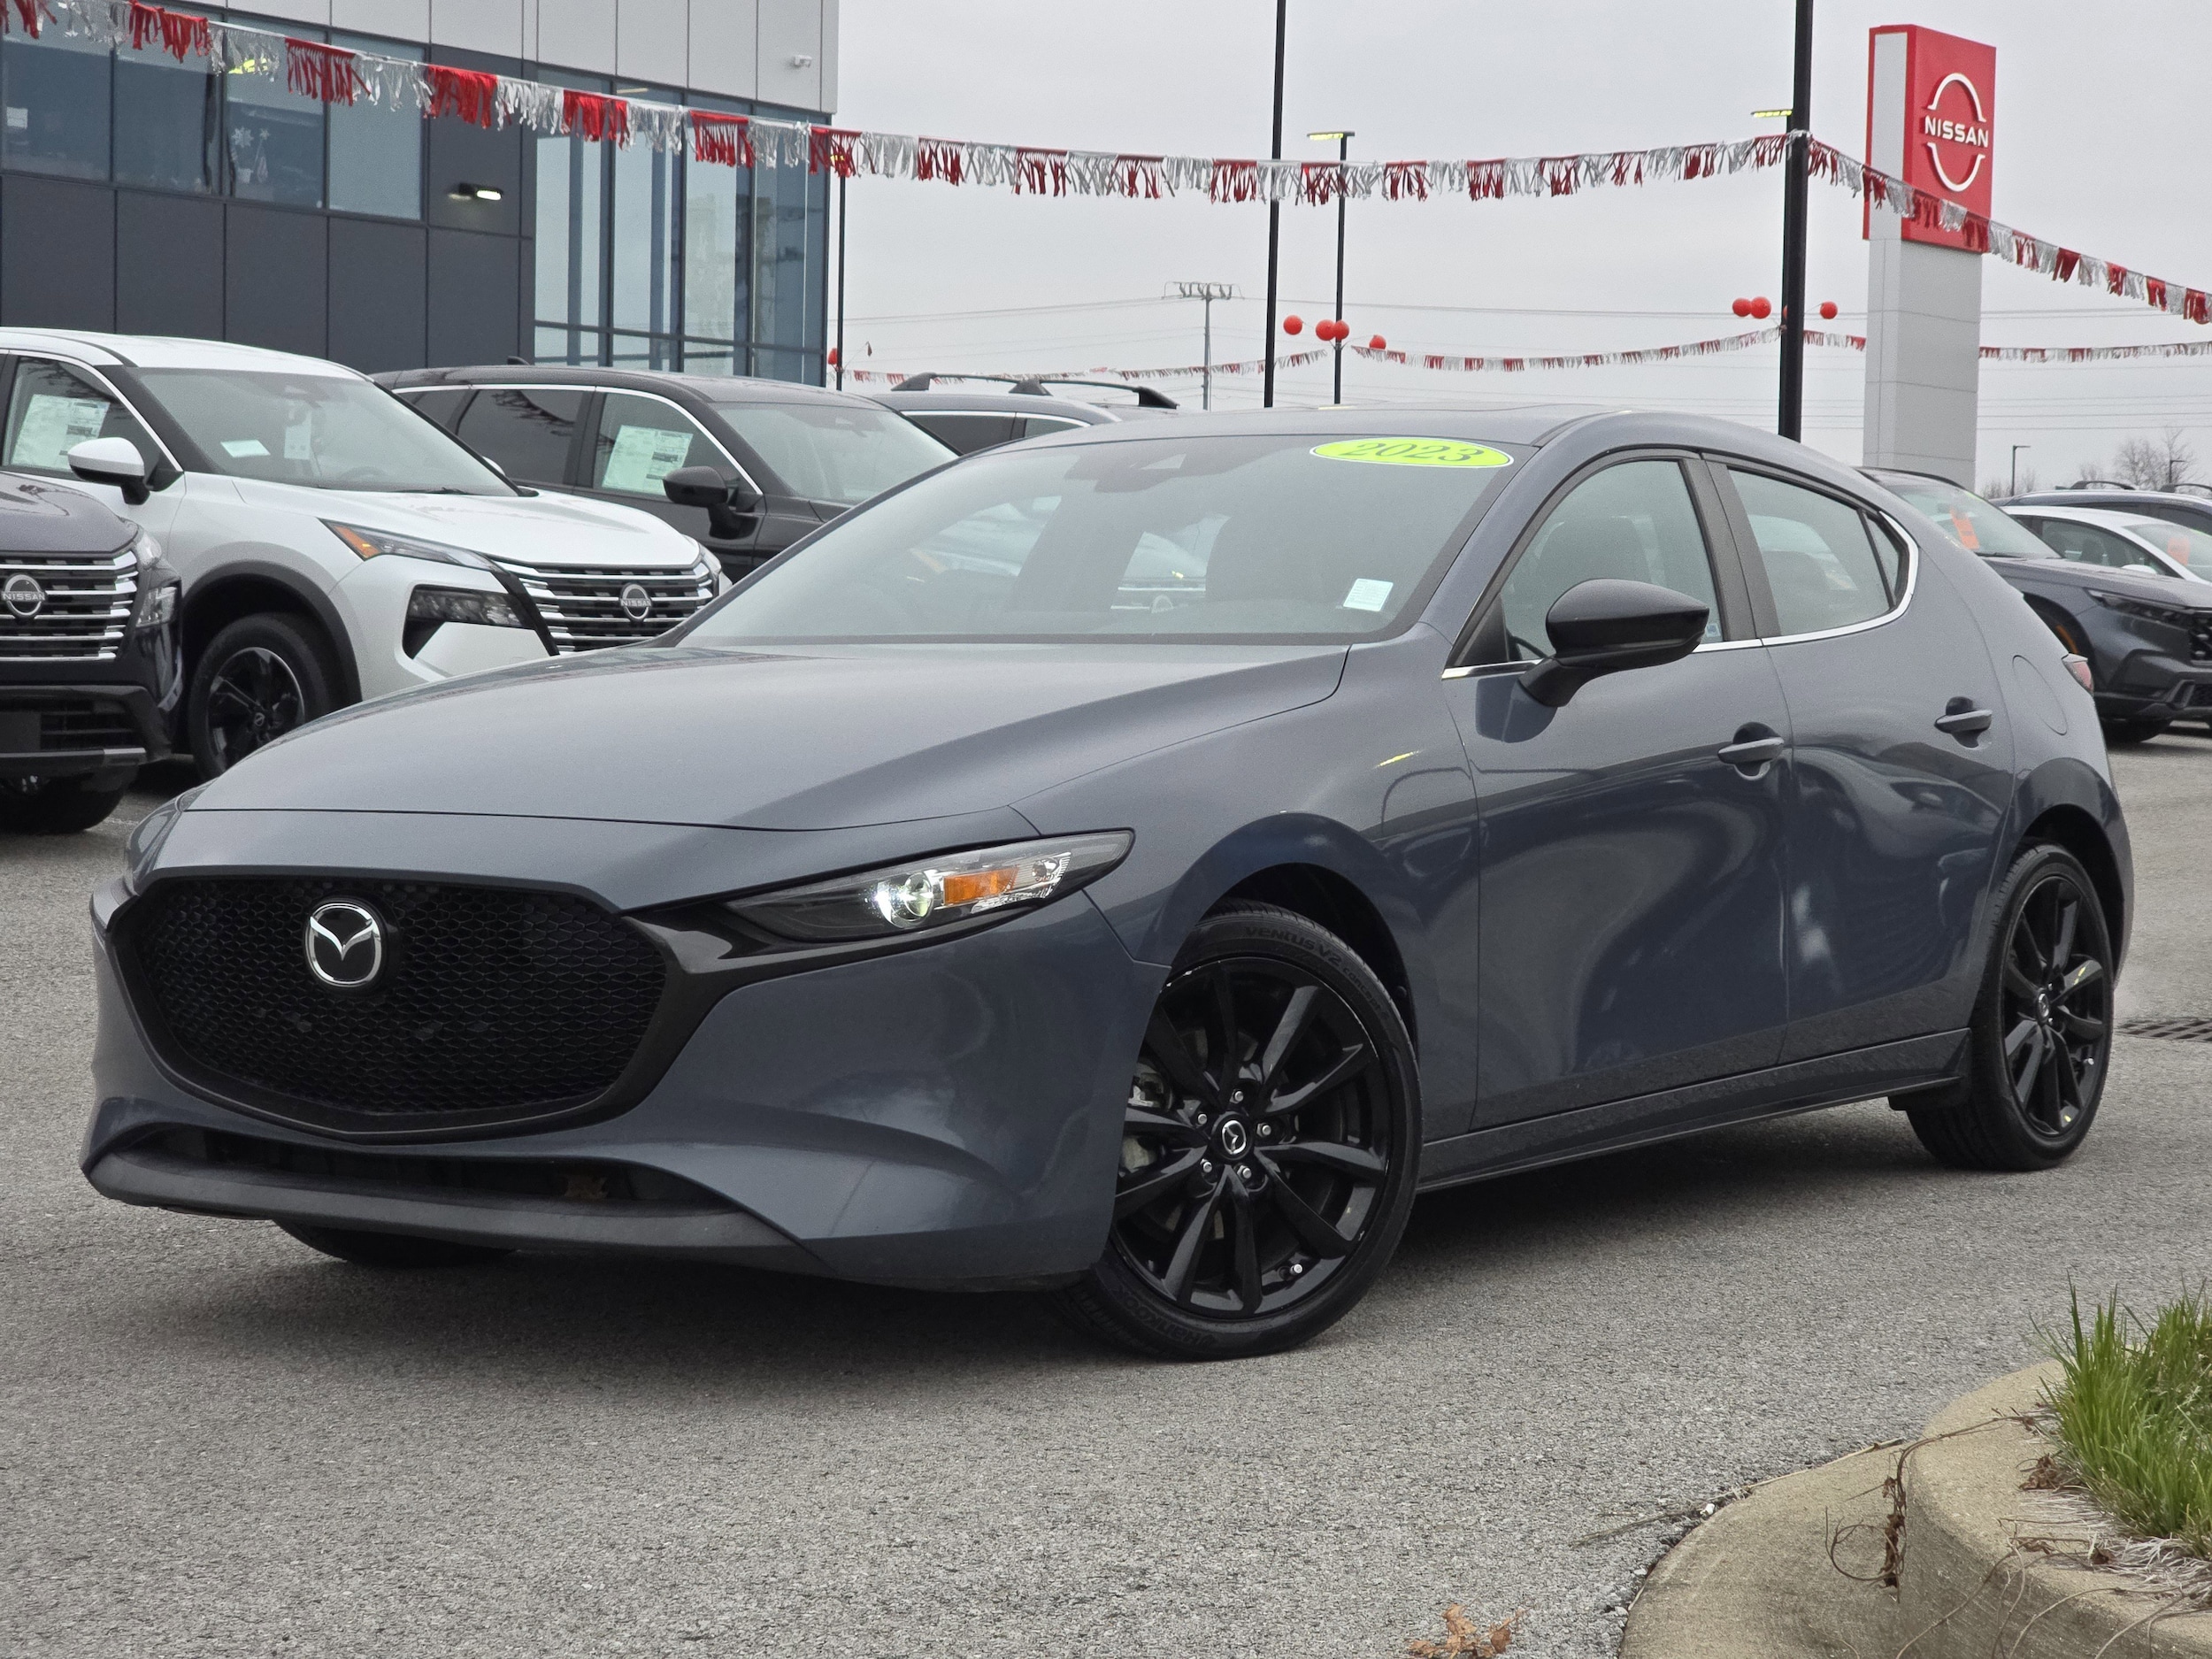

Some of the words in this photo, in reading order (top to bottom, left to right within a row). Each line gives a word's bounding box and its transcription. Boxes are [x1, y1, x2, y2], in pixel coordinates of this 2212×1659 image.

[1924, 116, 1988, 148] NISSAN
[1340, 442, 1485, 462] 2023
[620, 598, 652, 607] NISSAN
[1318, 943, 1342, 968] V2
